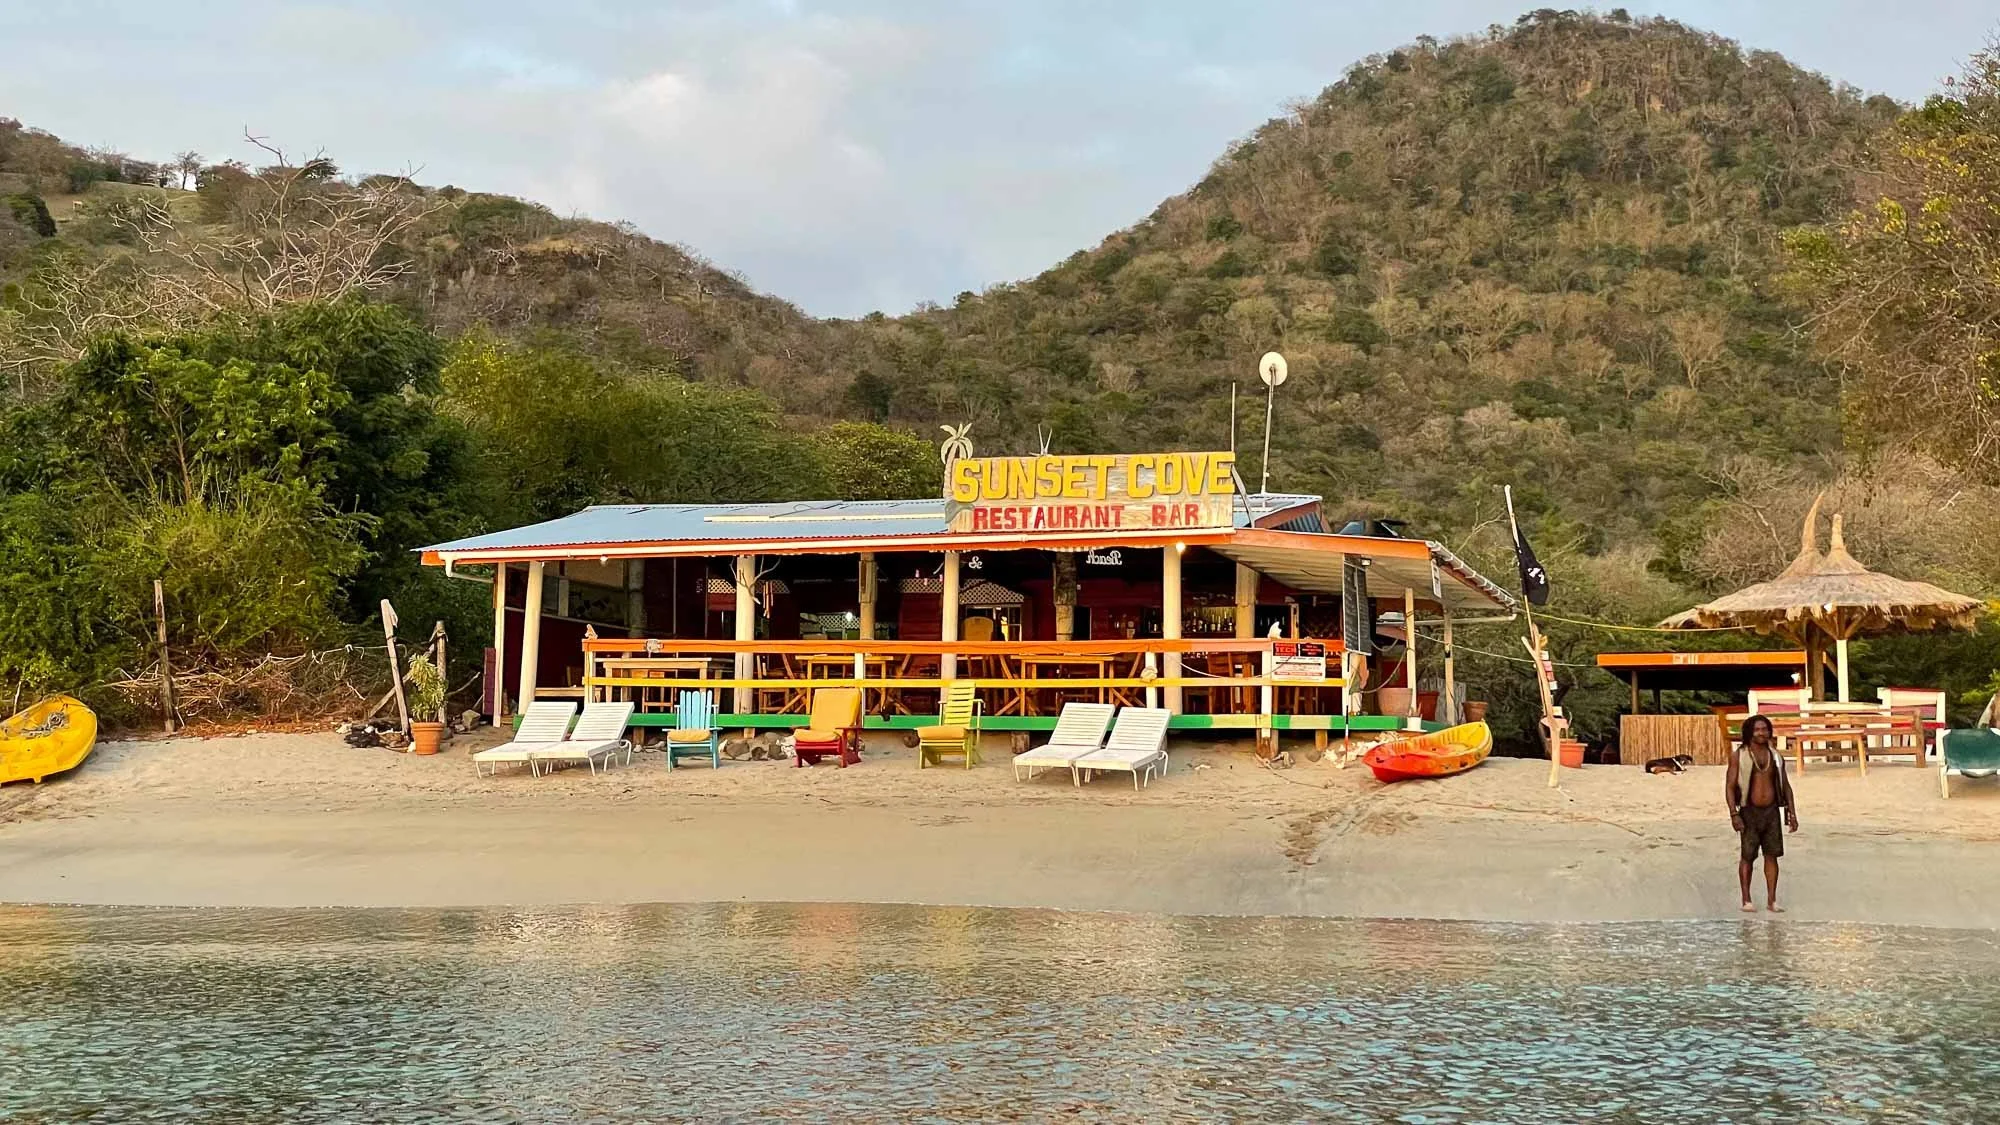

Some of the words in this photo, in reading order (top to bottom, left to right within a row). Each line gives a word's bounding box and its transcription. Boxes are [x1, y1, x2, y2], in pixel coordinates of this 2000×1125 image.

[954, 457, 1116, 502] SUNSET
[1127, 452, 1235, 498] COVE
[973, 505, 1125, 530] RESTAURANT
[1151, 503, 1199, 527] BAR
